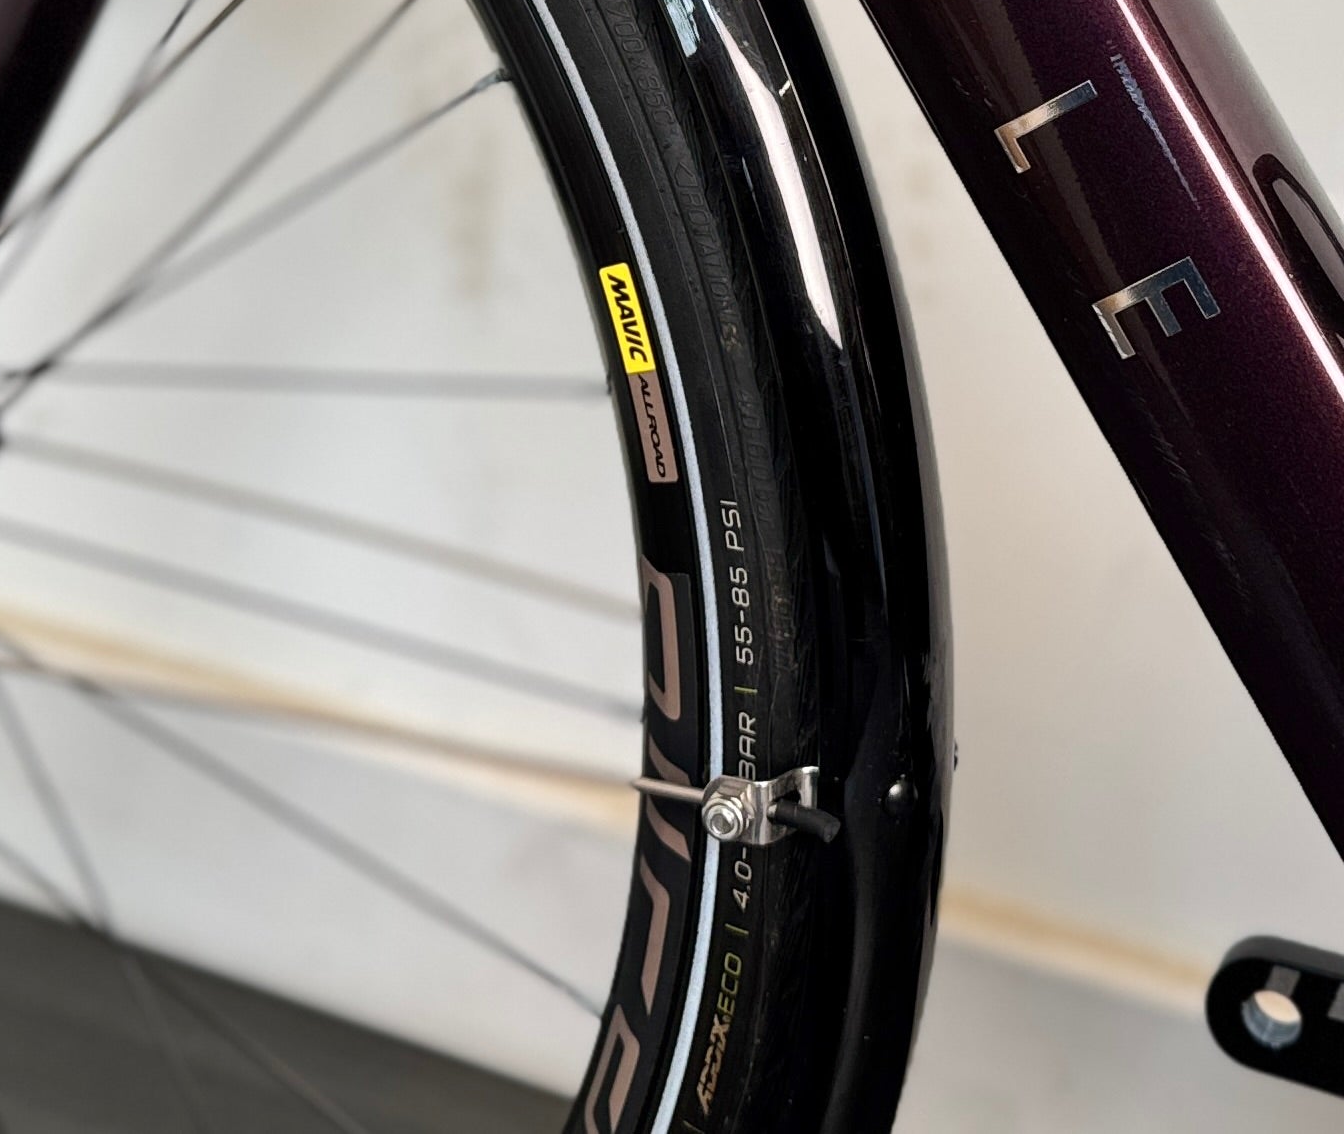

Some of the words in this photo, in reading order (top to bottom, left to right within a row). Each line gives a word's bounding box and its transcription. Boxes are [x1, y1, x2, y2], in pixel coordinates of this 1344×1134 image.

[607, 273, 649, 364] MAVIC
[637, 374, 666, 478] ALLROAD
[720, 500, 744, 552] PSI
[729, 567, 754, 666] 55-85
[739, 711, 757, 782] BAR
